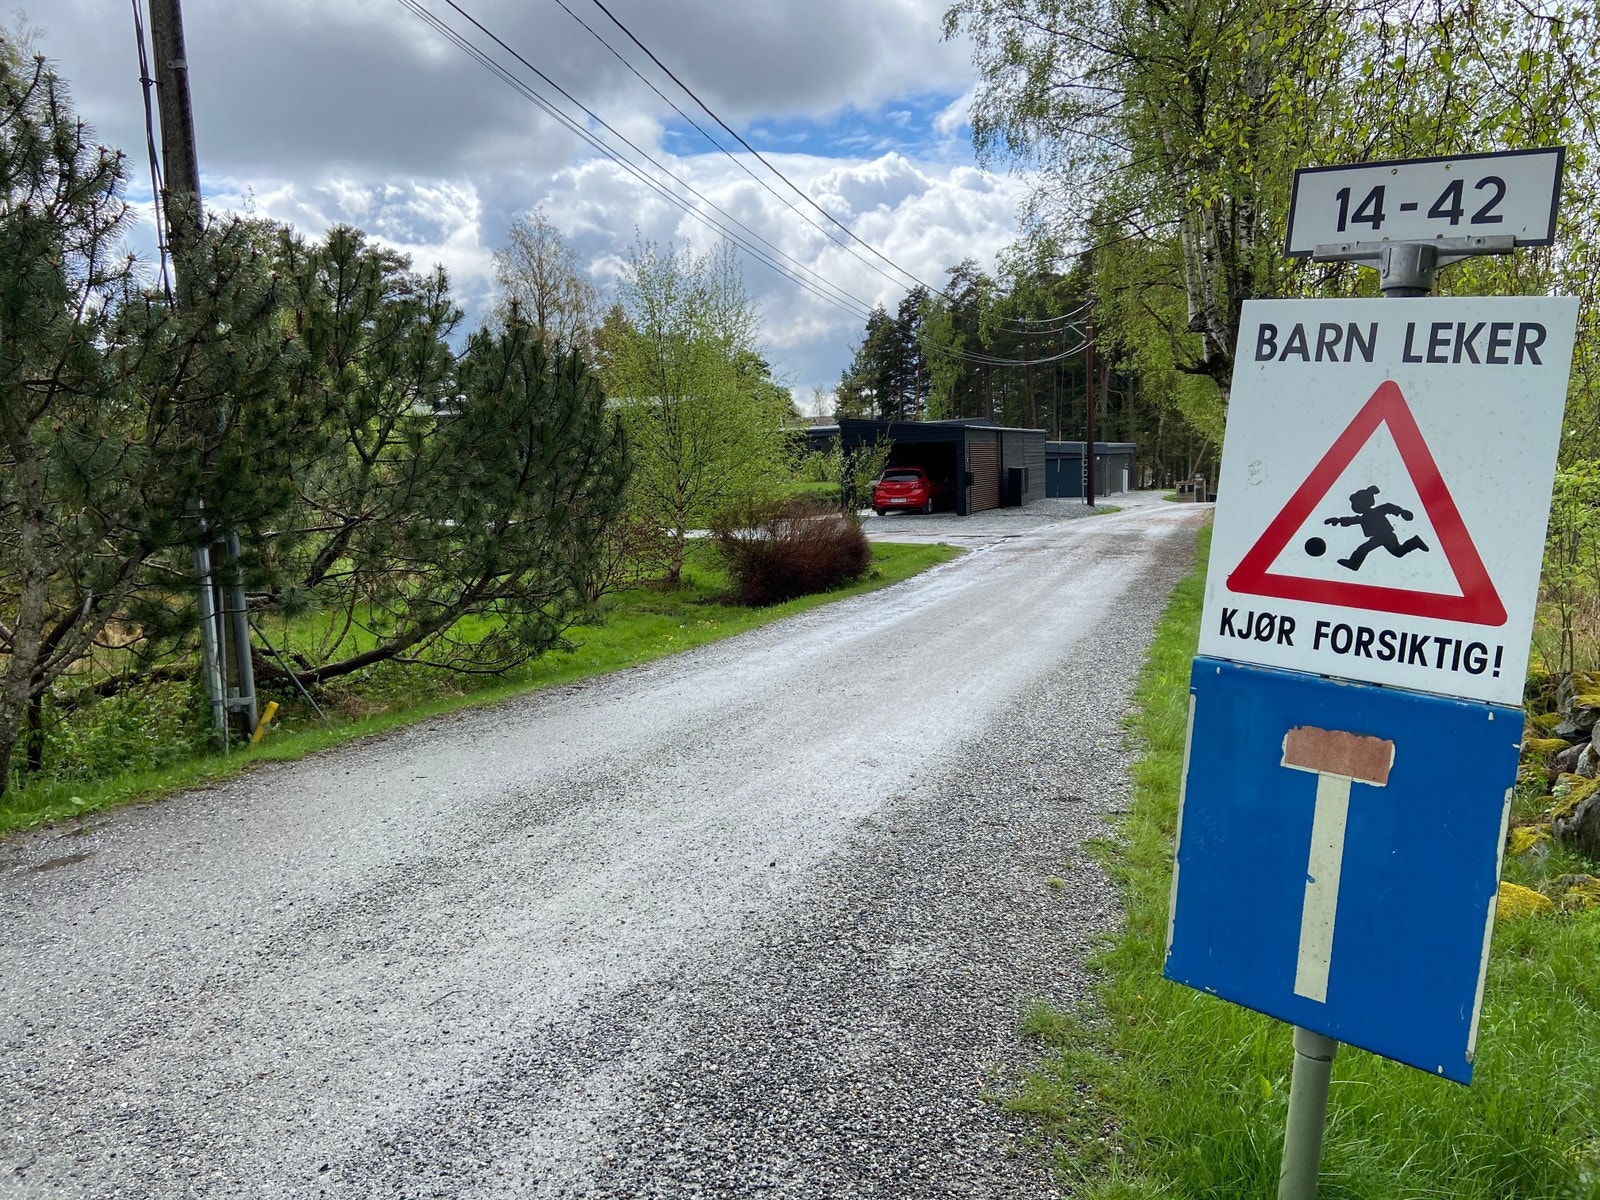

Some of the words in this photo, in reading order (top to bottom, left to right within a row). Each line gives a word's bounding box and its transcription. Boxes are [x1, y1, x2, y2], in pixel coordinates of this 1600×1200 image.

[1254, 322, 1379, 363] BARN
[1401, 321, 1547, 366] LEKER
[1219, 607, 1296, 647] KJØR
[1312, 620, 1504, 678] FORSIKTIG!
